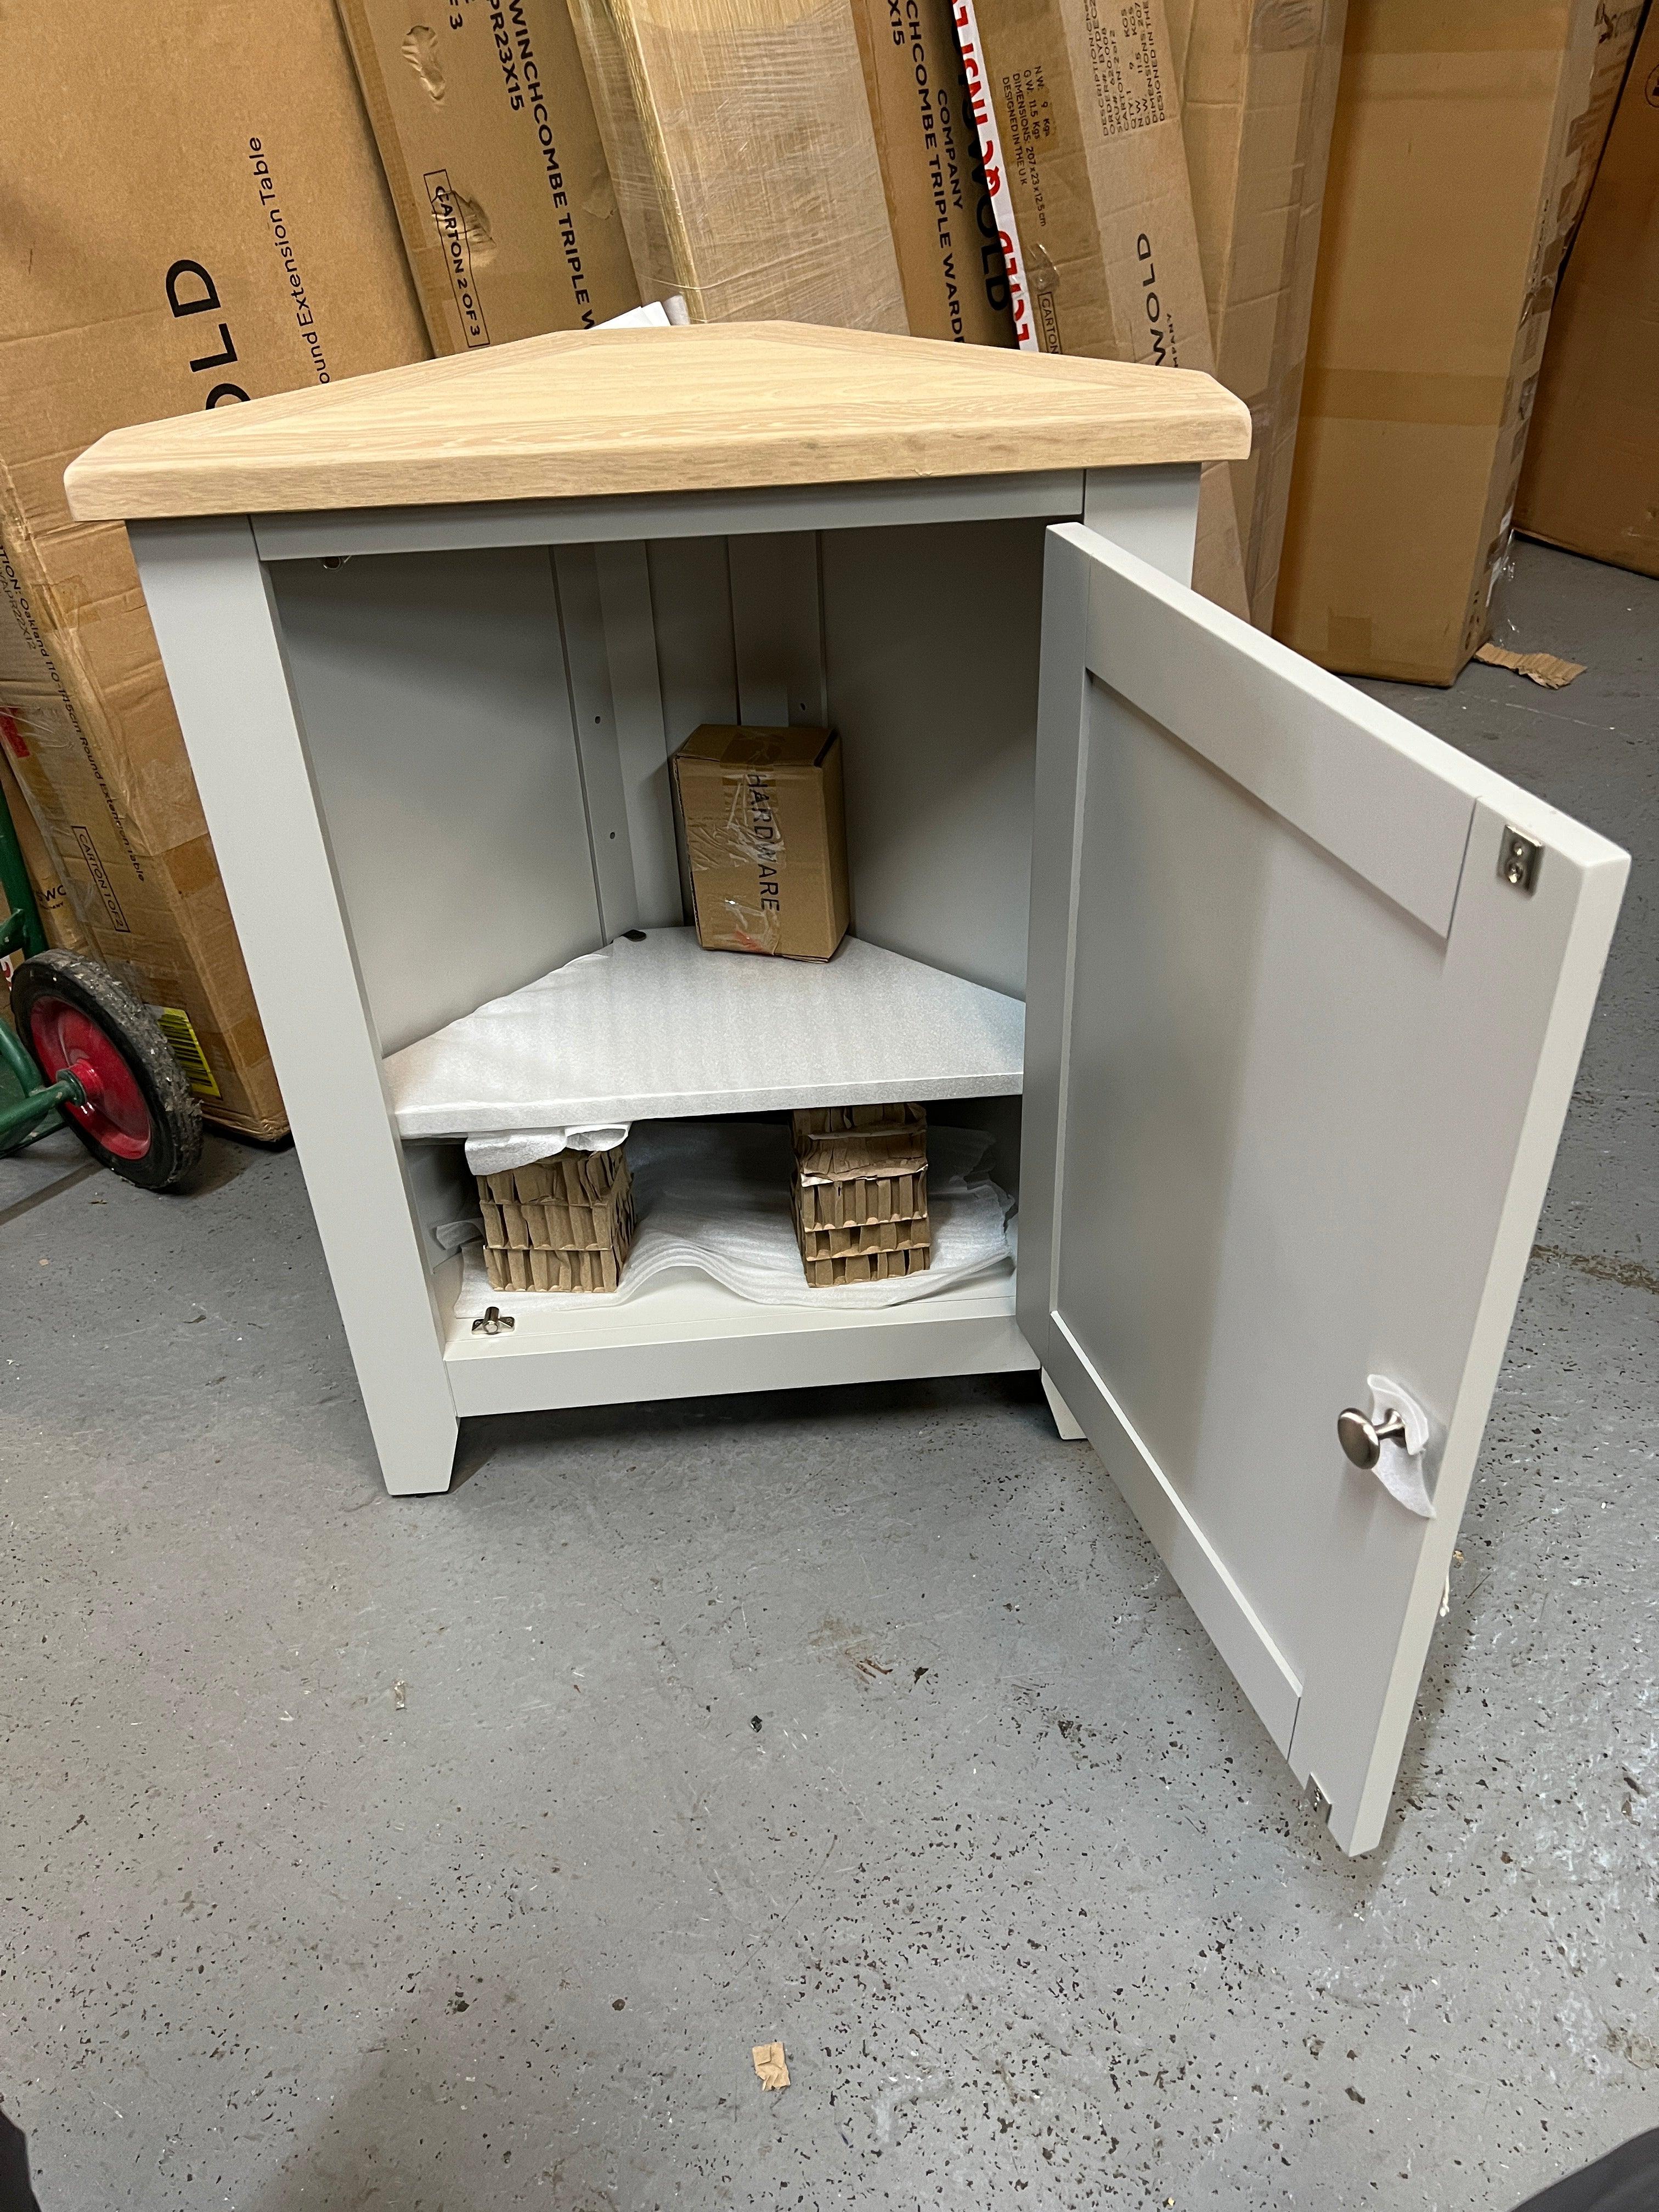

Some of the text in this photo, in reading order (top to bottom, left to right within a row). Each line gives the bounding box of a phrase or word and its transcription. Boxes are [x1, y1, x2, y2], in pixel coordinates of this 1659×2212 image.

[450, 13, 462, 29] 3
[1148, 32, 1154, 46] IN
[509, 0, 568, 208] WINCHCOMBE
[558, 212, 590, 304] TRIPLE
[906, 0, 937, 150] CHCOMBE
[929, 155, 951, 249] TRIPLE
[938, 89, 963, 210] COMPANY
[1002, 77, 1018, 132] DESIGNED
[1026, 146, 1036, 165] 207
[249, 137, 275, 206] Table
[269, 208, 314, 326] Extension
[435, 185, 480, 335] CARTON 2 OF 3
[1137, 233, 1166, 366] WOLD
[1041, 298, 1059, 354] CARTON
[20, 598, 49, 657] Oakland
[80, 737, 103, 779] Round
[99, 783, 129, 847] Extension
[79, 833, 107, 889] CARTON
[747, 773, 780, 912] HARDWARE
